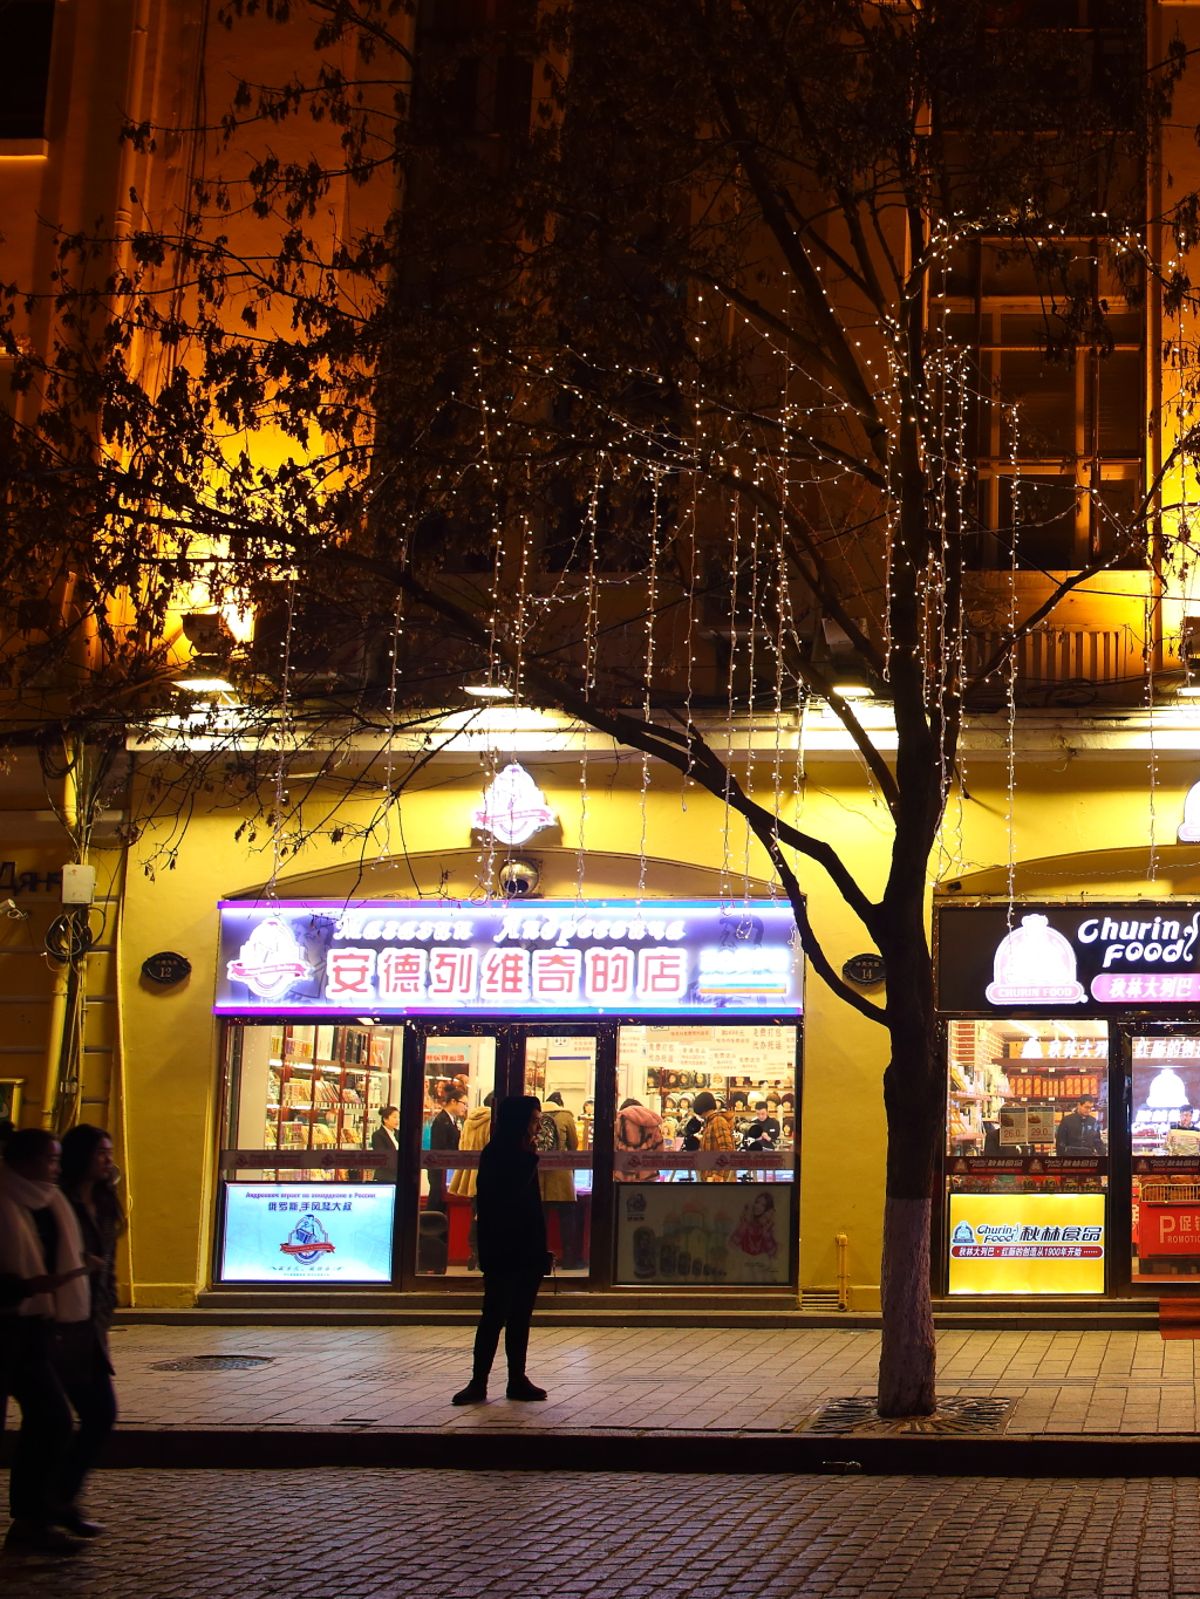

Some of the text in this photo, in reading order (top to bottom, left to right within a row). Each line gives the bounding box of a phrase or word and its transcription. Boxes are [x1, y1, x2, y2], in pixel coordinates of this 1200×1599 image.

[1078, 916, 1180, 943] Churin
[329, 951, 683, 996] 安德列维奇的店
[1020, 1226, 1102, 1241] 秋林食品
